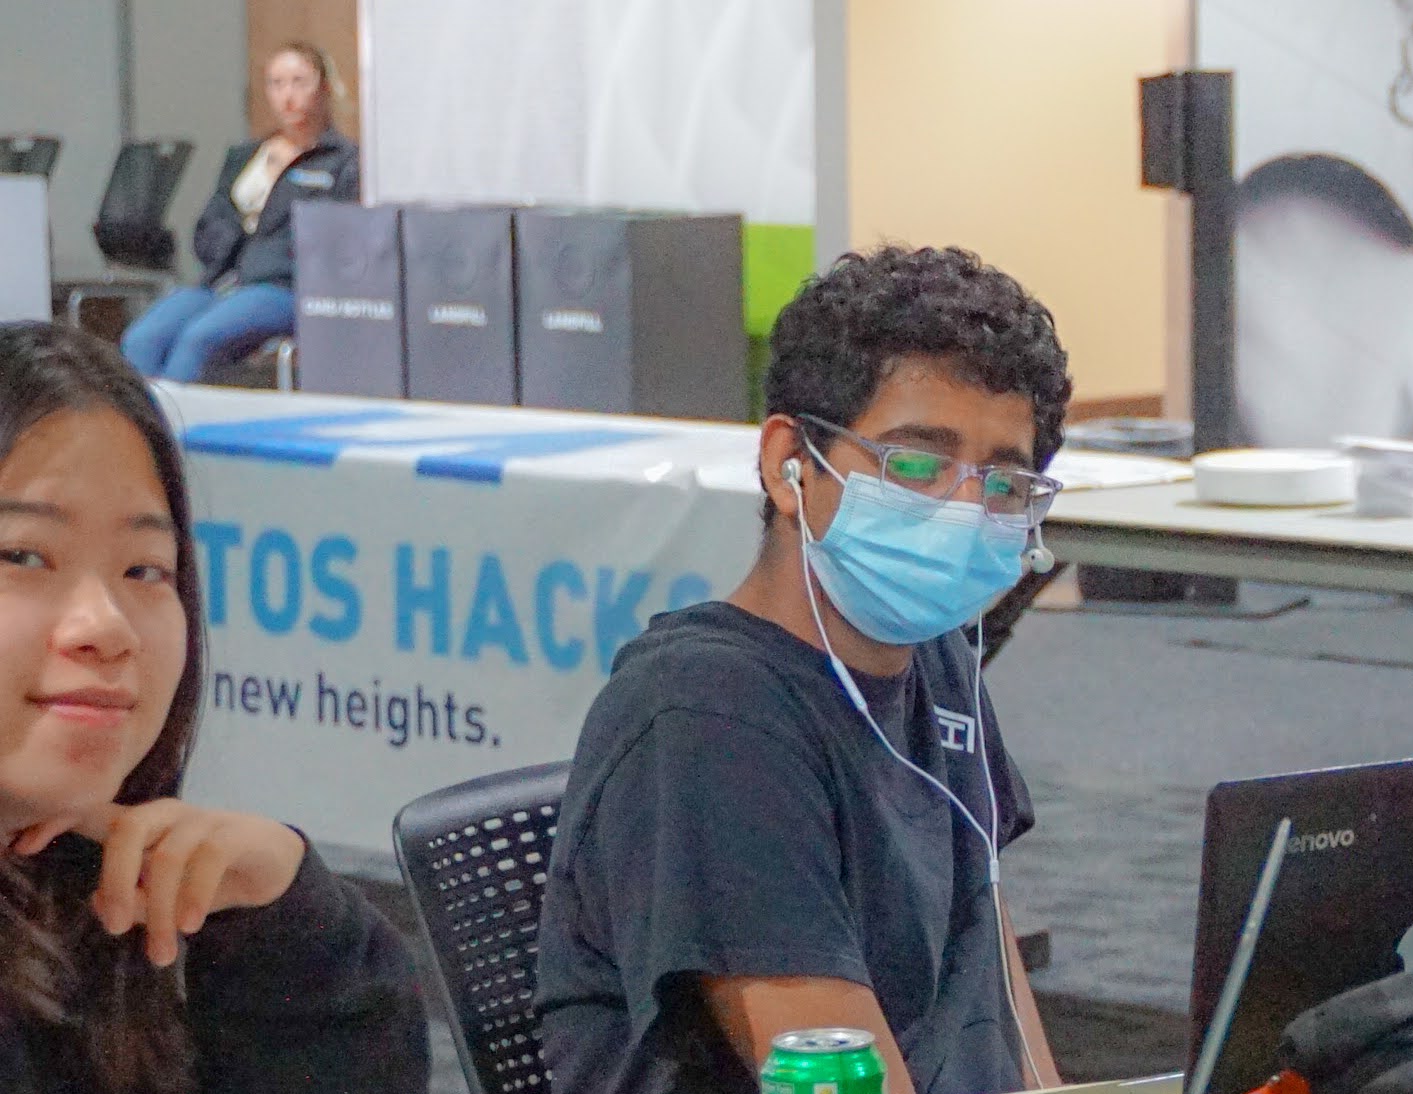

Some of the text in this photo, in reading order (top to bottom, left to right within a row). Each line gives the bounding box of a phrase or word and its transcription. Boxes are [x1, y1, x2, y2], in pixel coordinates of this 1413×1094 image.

[213, 671, 500, 749] new heights.
[1286, 829, 1355, 853] enovo
